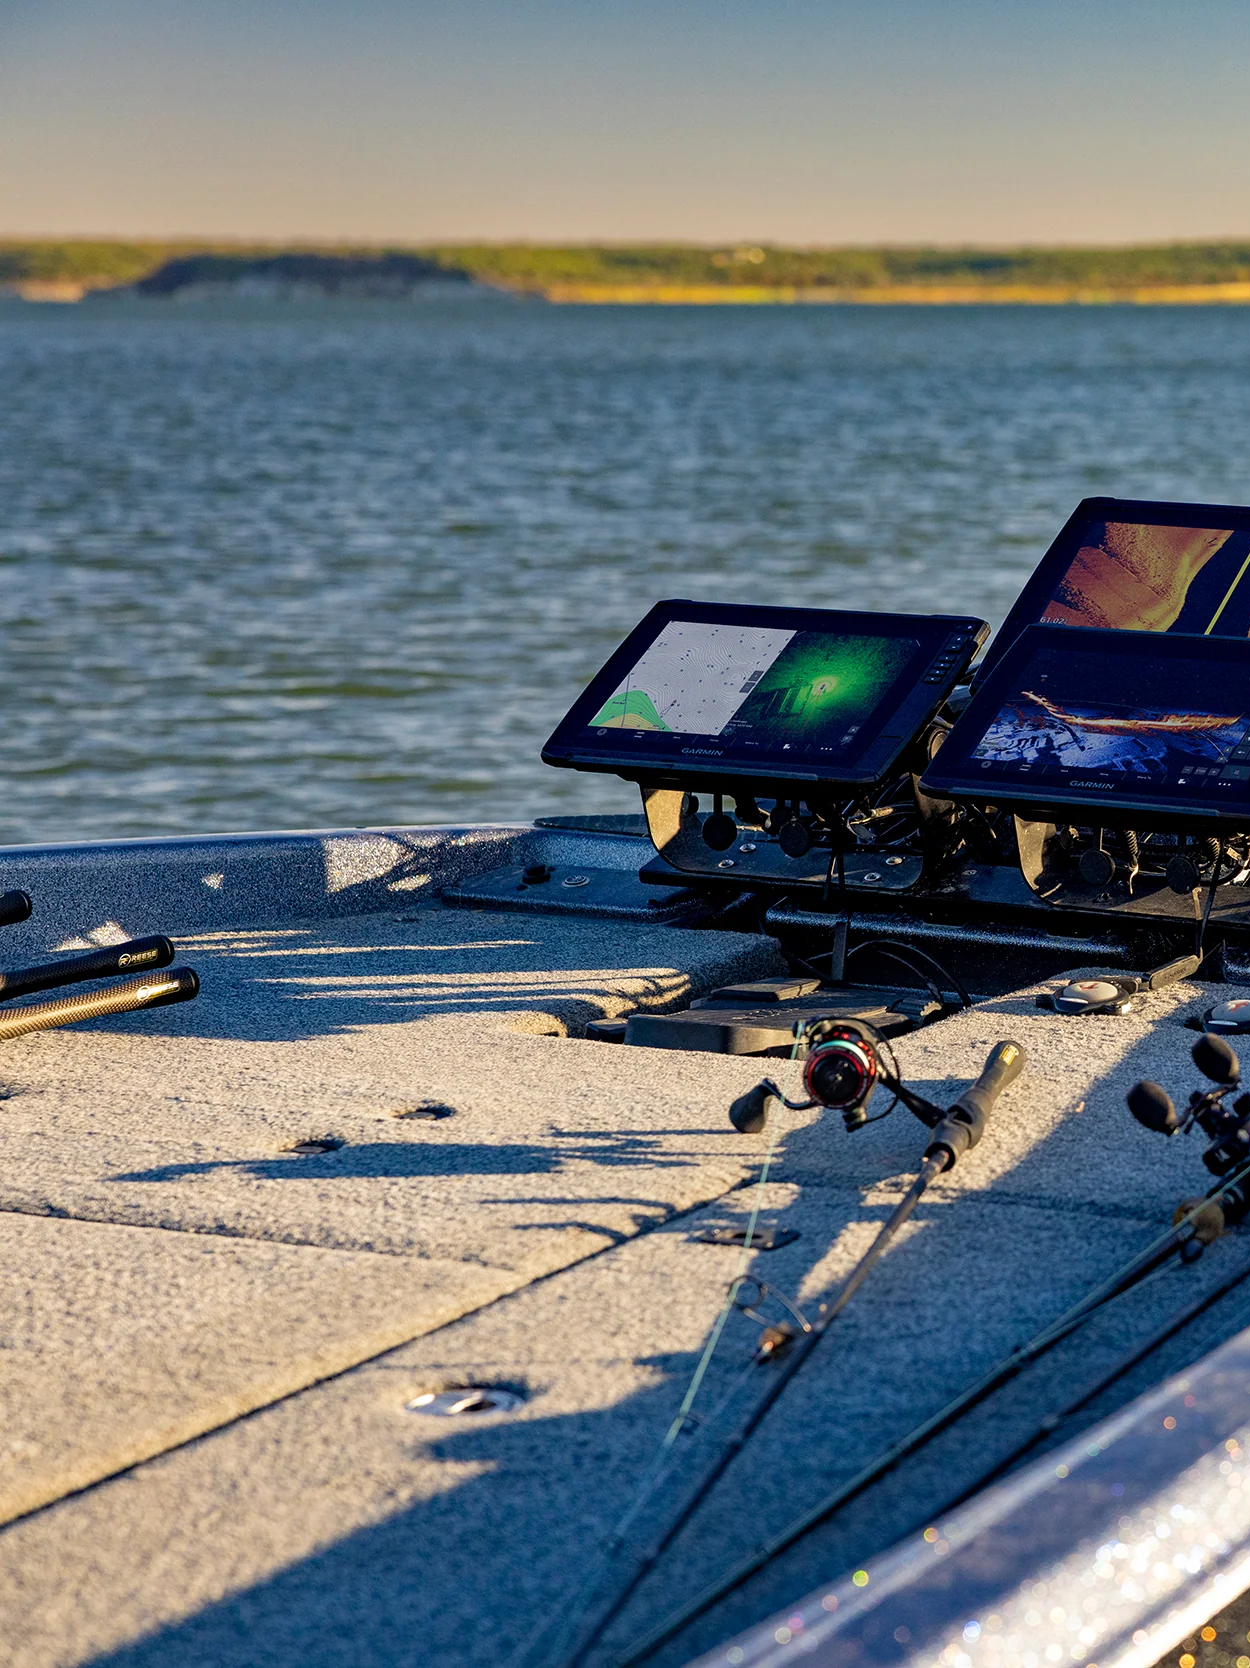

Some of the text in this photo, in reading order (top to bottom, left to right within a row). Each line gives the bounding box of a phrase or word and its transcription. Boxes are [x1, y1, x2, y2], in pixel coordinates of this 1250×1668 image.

[681, 747, 724, 756] GARMIN
[1069, 780, 1115, 790] GARMIN
[131, 949, 158, 963] REESE
